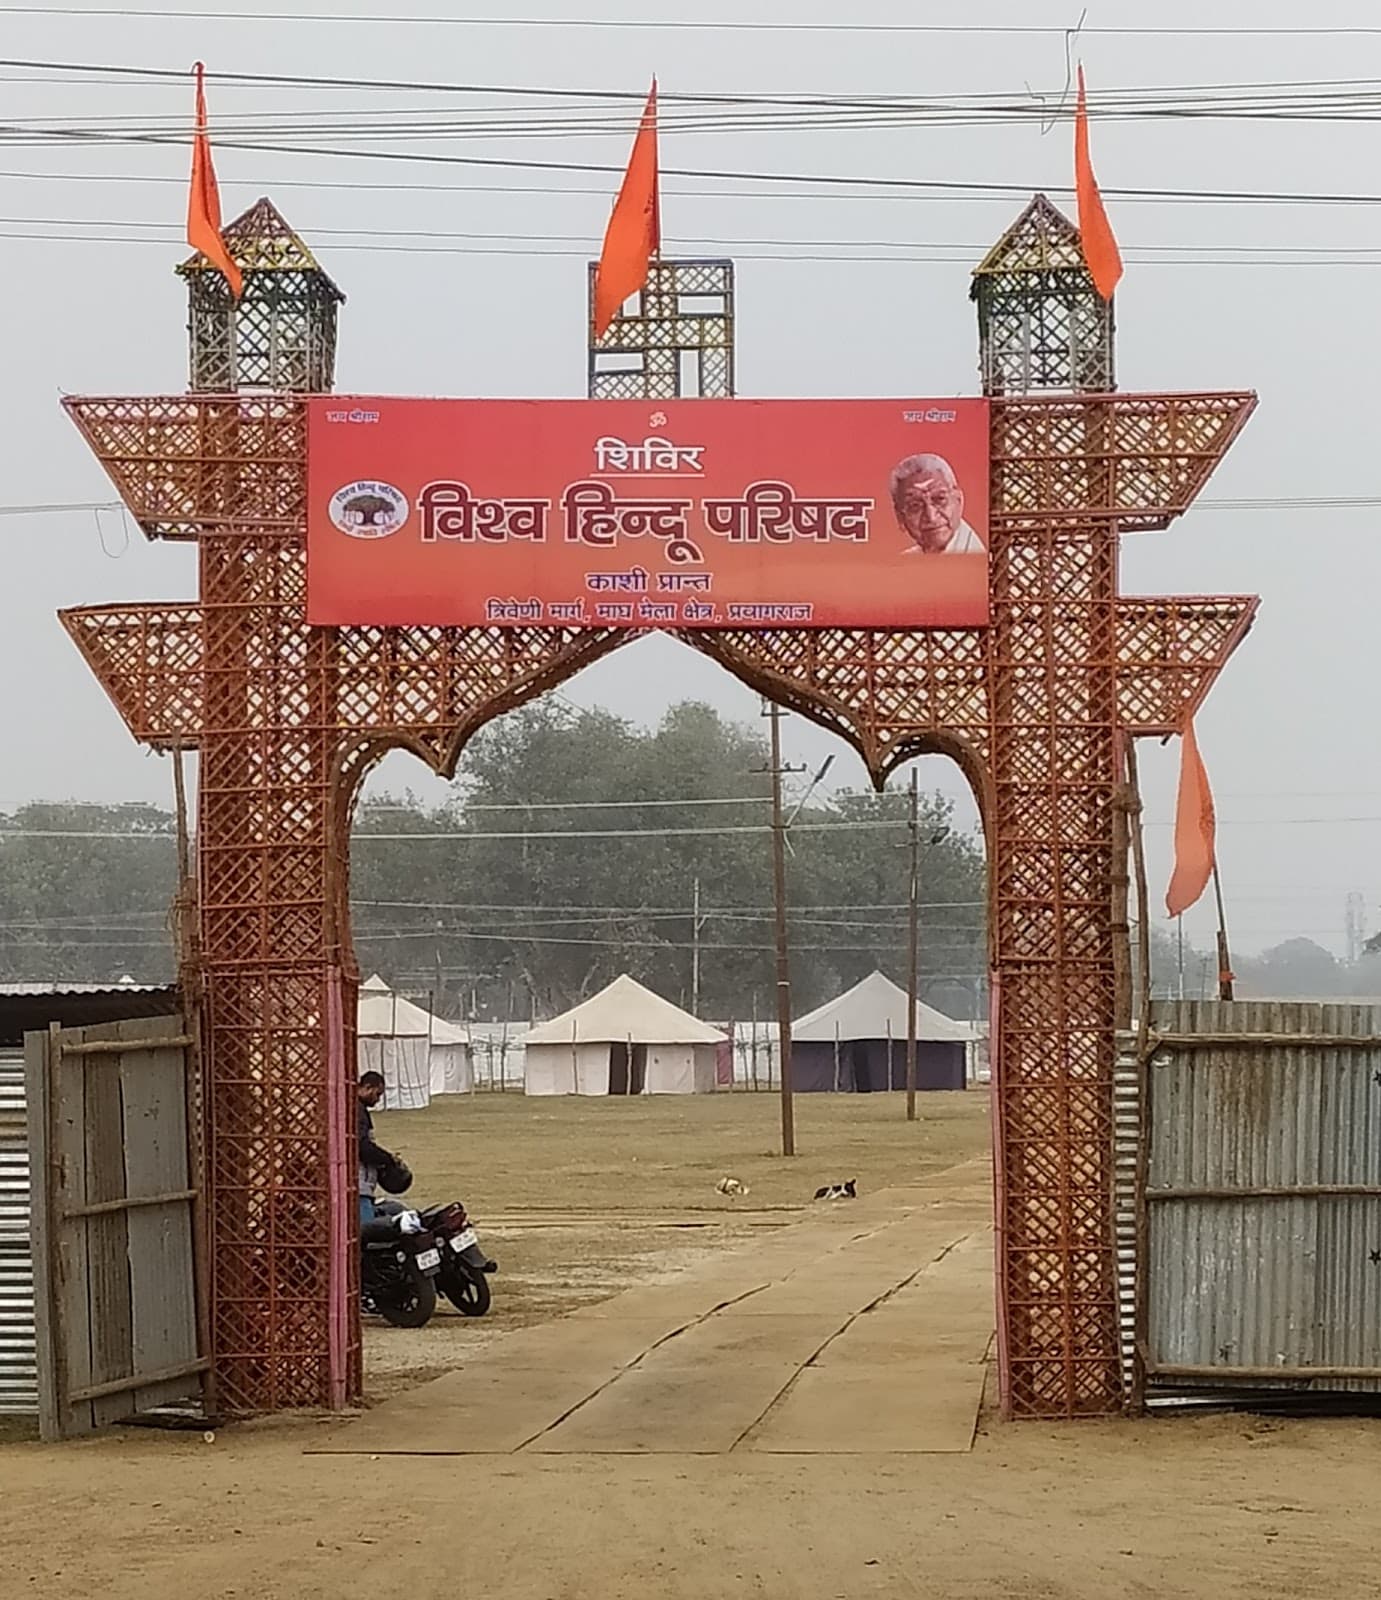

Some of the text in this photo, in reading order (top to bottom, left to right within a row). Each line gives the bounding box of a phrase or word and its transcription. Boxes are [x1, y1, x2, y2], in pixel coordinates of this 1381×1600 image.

[593, 436, 705, 471] शिविर
[416, 480, 874, 565] विश्व हिन्दू परिषद
[585, 565, 712, 593] काशी प्रान्त
[485, 597, 814, 623] त्रिवेणी मार्ग, माघ मेला क्षेत्र, प्रयागराज
